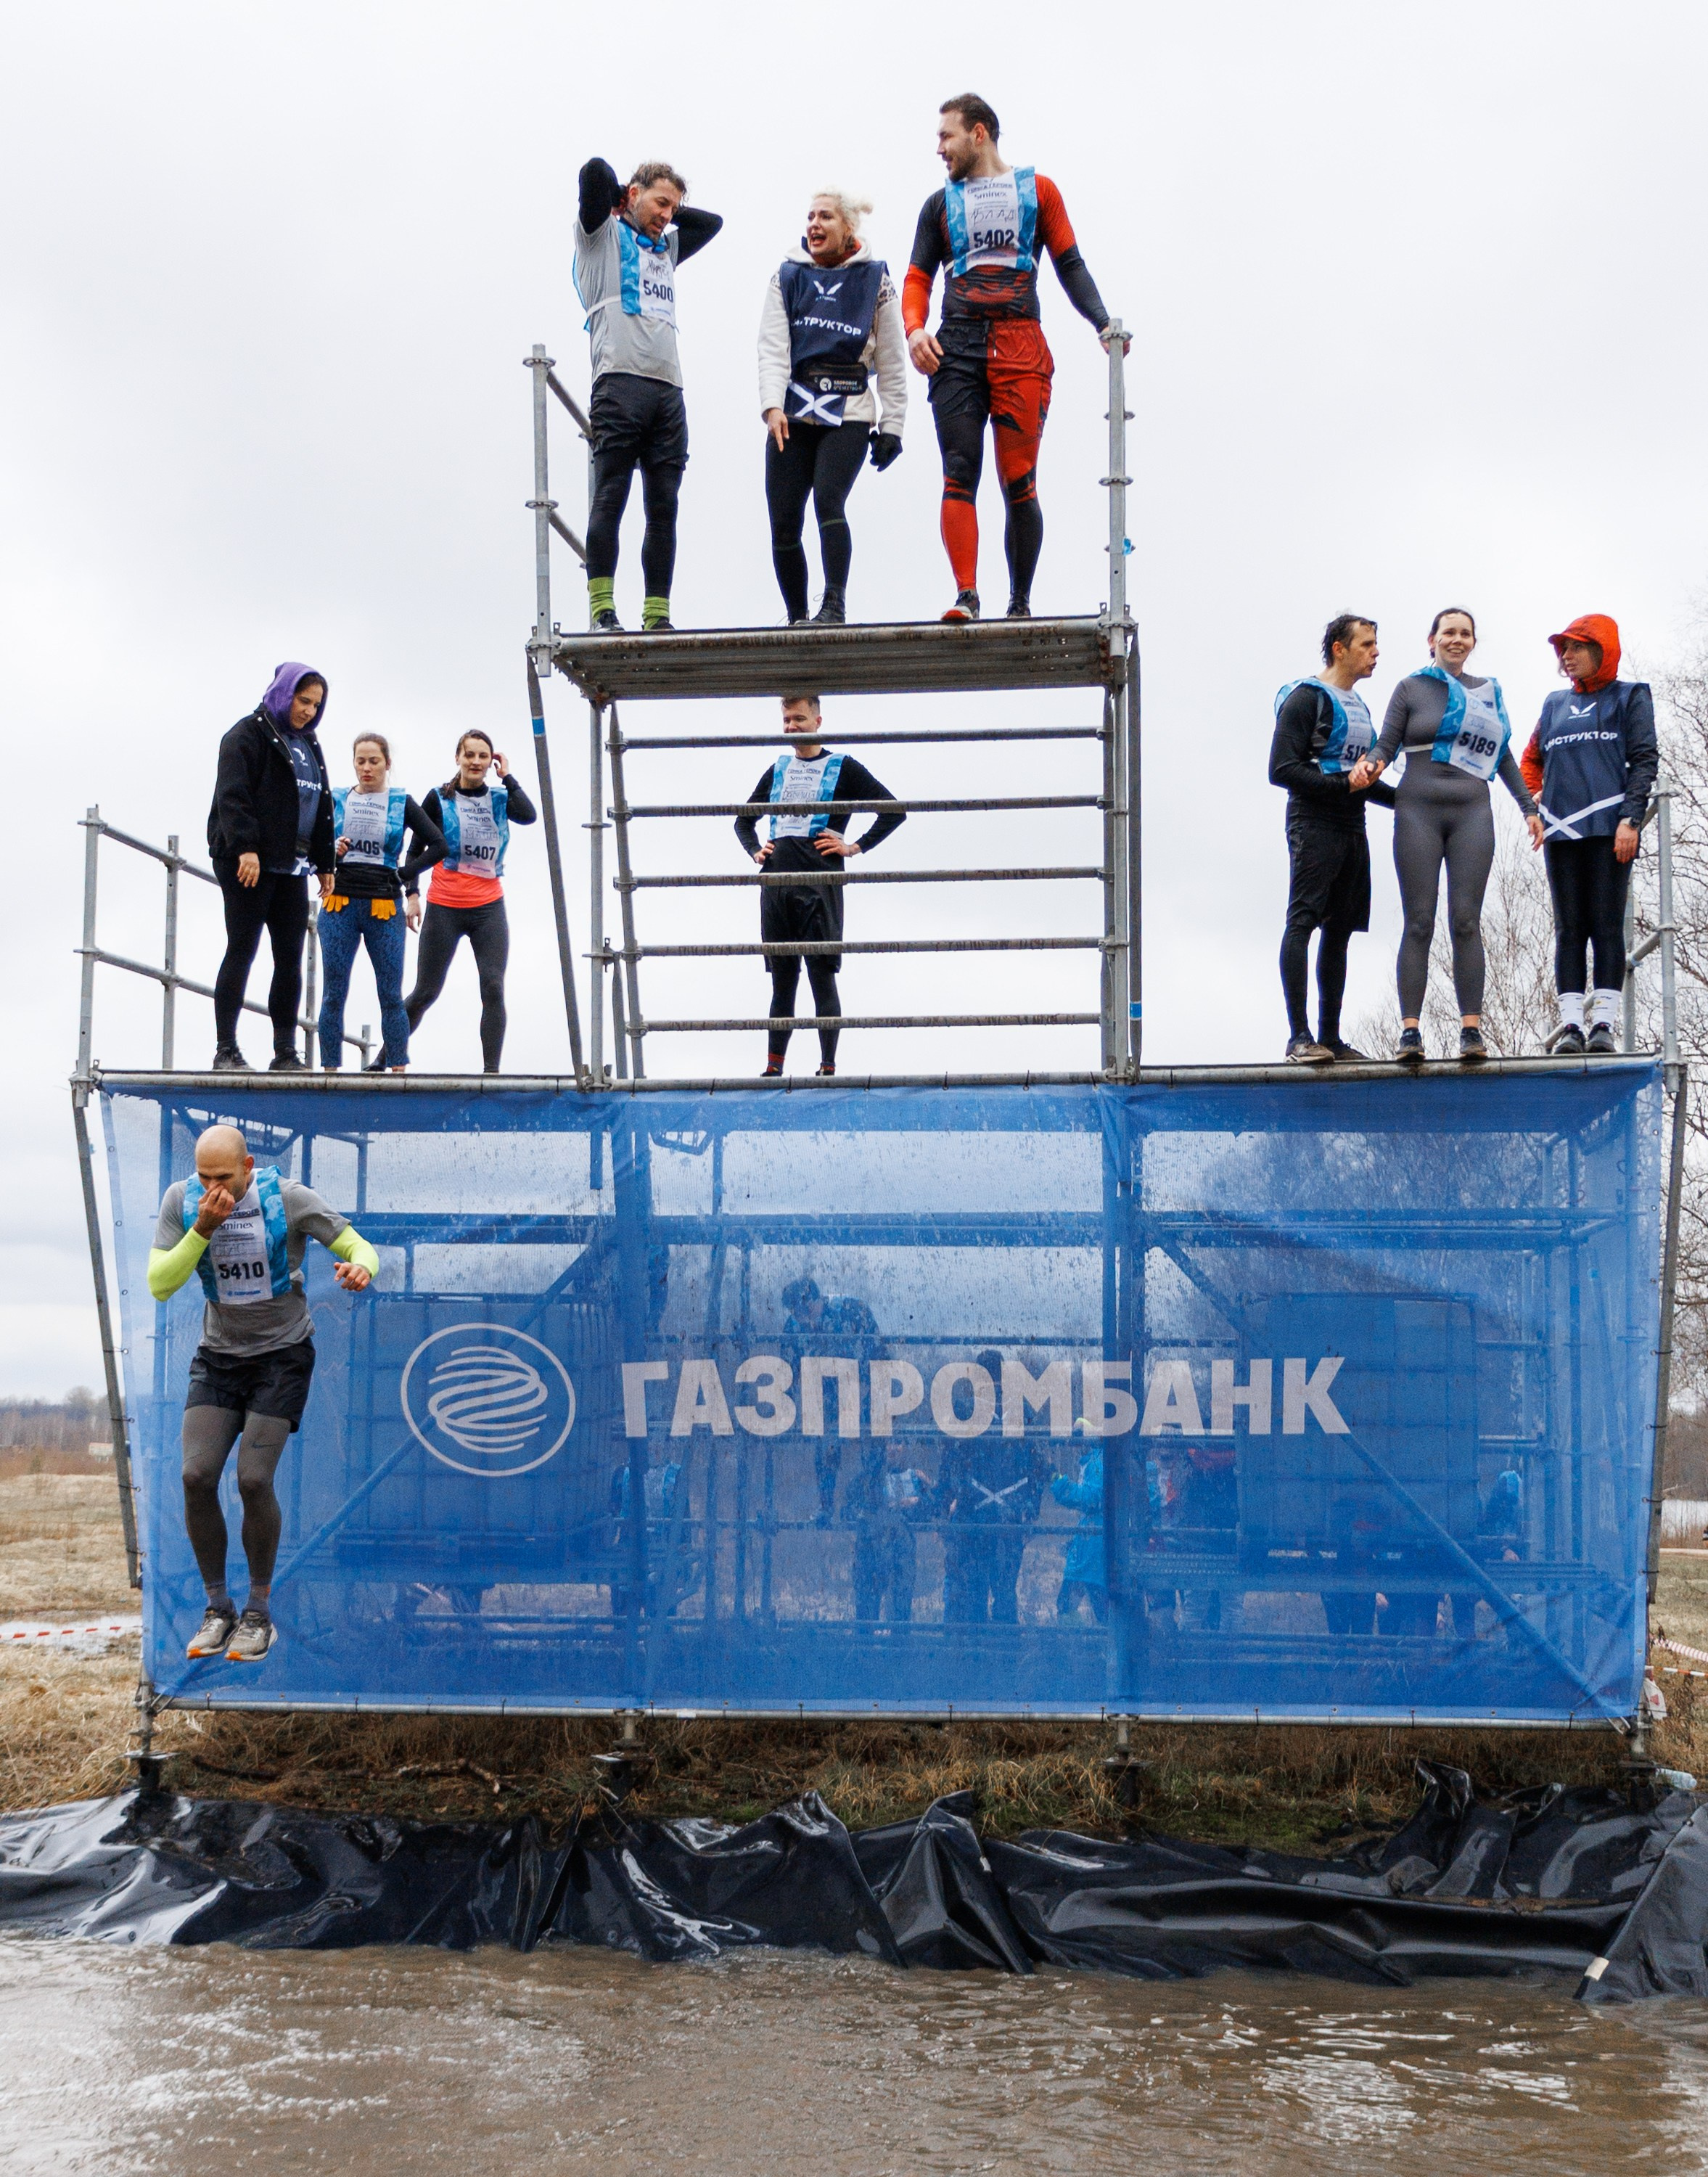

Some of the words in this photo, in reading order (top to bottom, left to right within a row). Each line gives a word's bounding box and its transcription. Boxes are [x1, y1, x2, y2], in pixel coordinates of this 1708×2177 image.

[973, 229, 1014, 249] 5402
[643, 279, 673, 303] 5400
[792, 316, 862, 336] ТРУКТОР
[1458, 731, 1497, 757] 5189
[464, 845, 496, 861] 5407
[218, 1261, 265, 1279] 5410
[622, 1355, 1351, 1438] ГАЗПРОМБАНК
